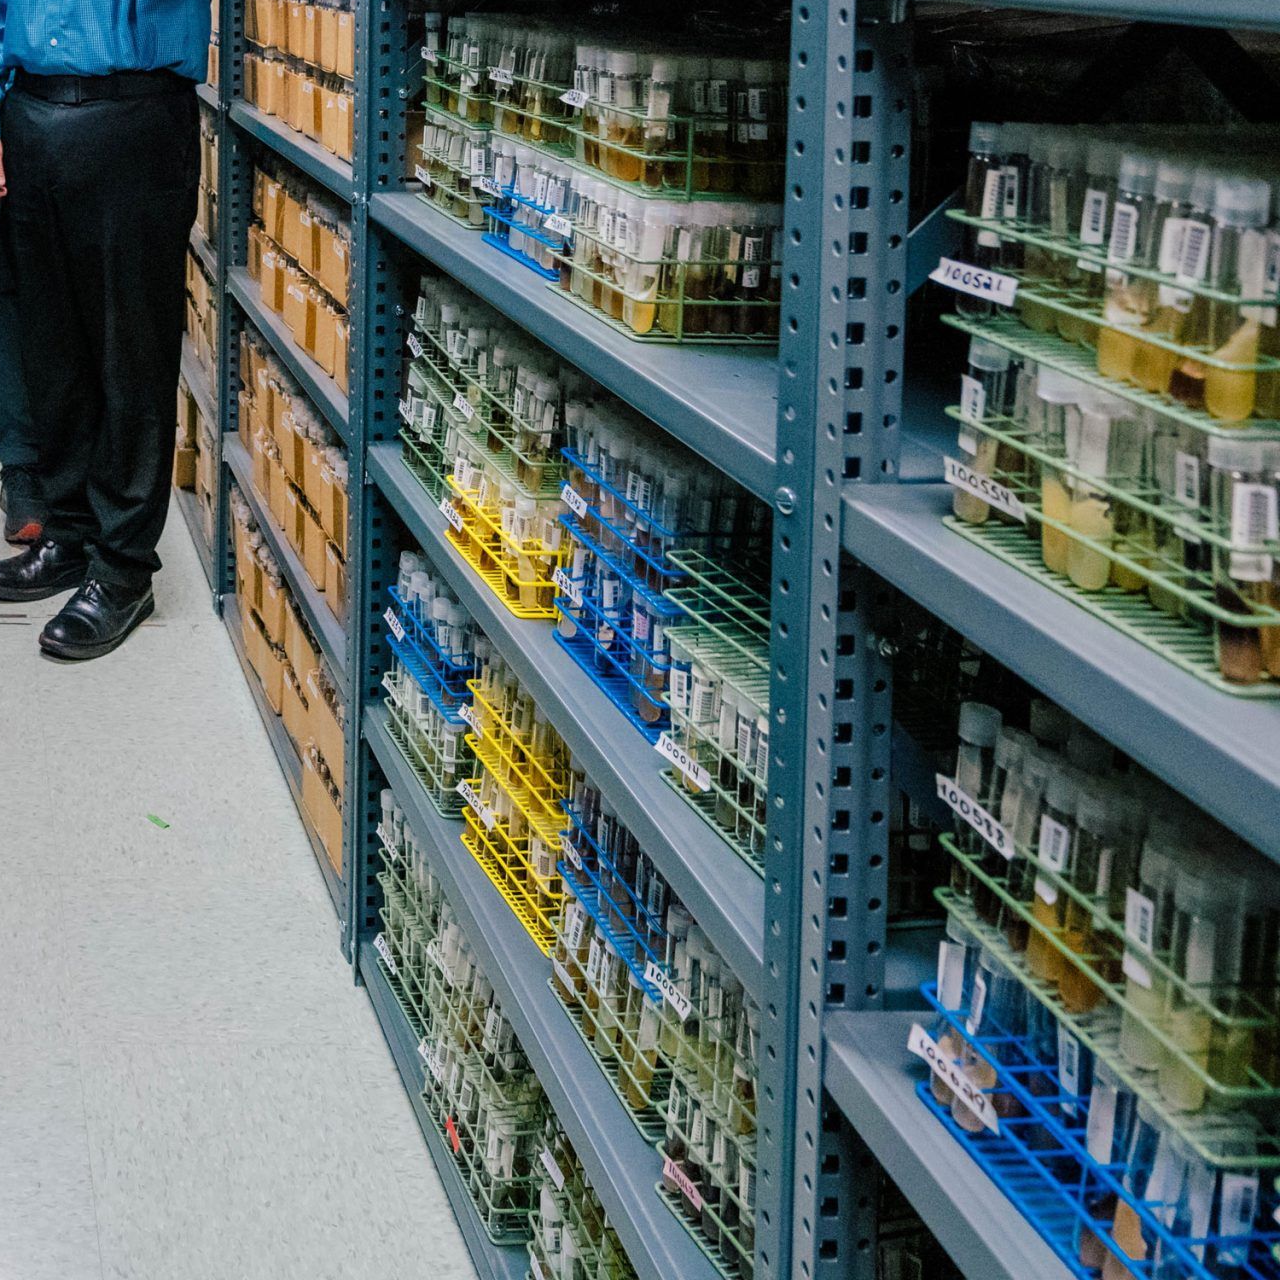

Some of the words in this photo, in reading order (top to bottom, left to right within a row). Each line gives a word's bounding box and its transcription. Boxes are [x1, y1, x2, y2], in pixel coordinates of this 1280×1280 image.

[945, 265, 1003, 292] 100521
[950, 465, 1010, 505] 100554
[662, 736, 700, 774] 100014
[939, 782, 1006, 850] 100588
[650, 967, 688, 1012] 100077
[917, 1038, 987, 1114] 100629
